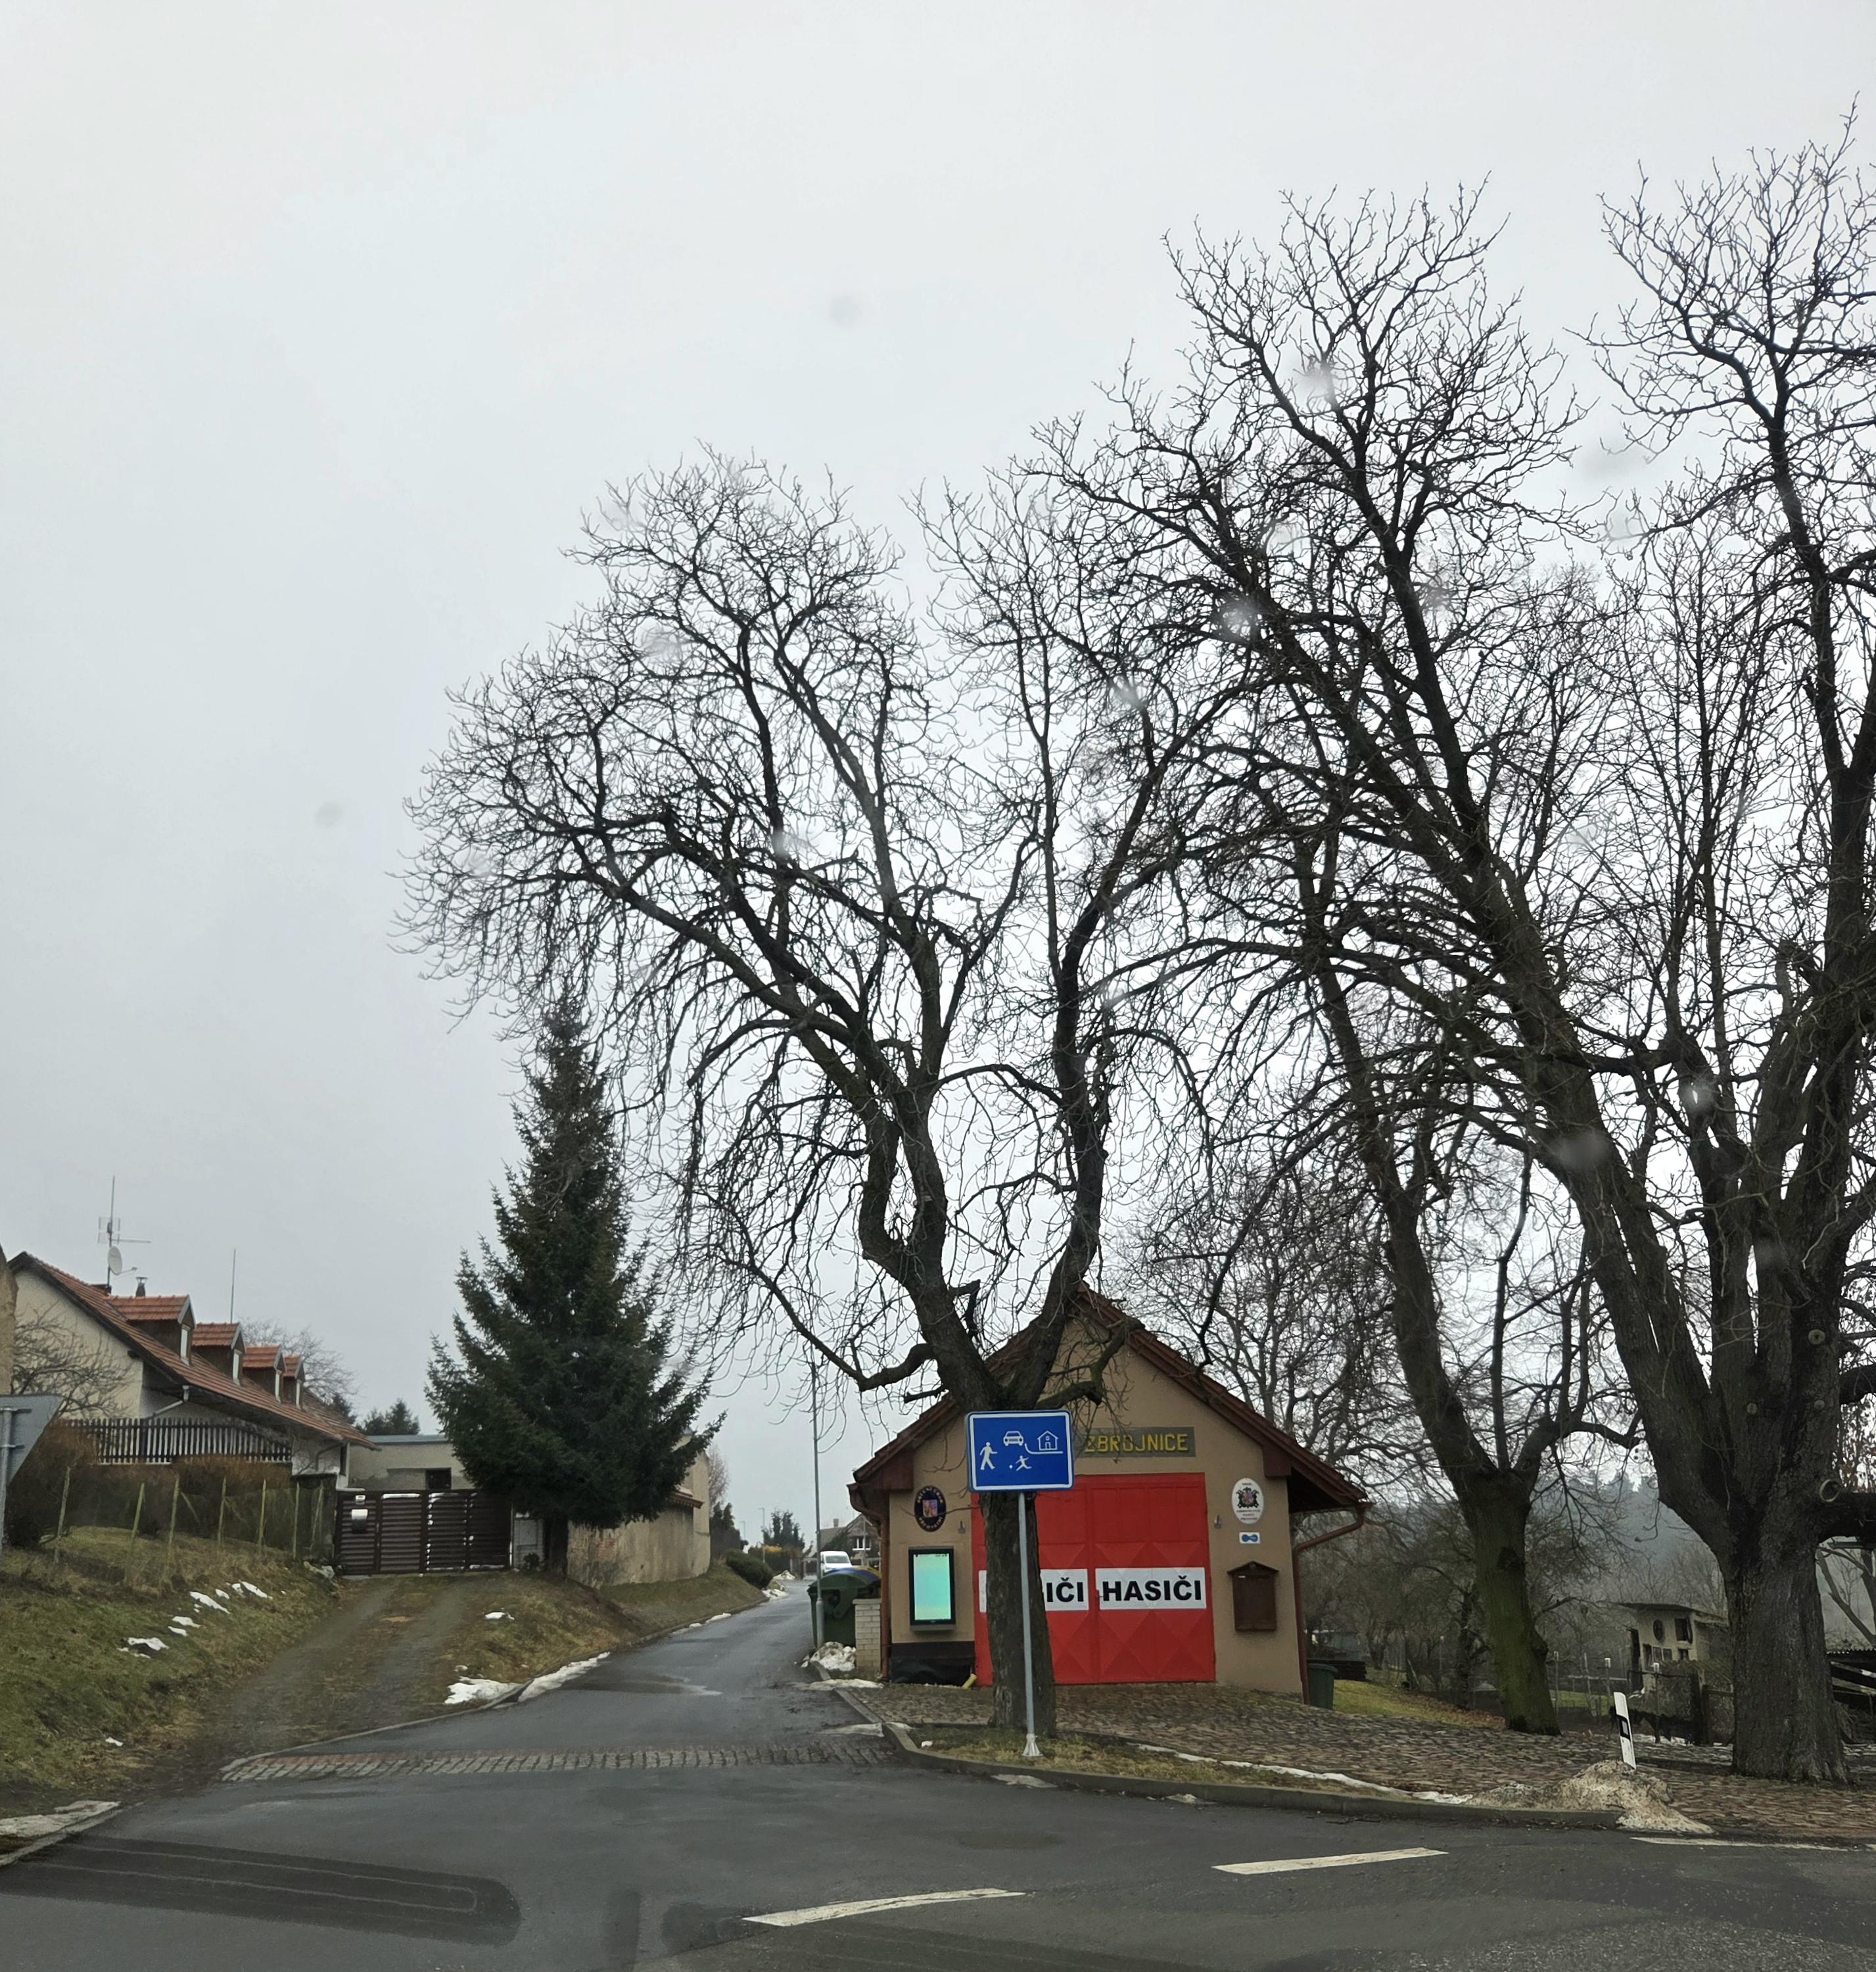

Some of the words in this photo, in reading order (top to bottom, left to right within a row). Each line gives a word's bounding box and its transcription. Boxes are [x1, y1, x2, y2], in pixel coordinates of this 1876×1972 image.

[1085, 1433, 1188, 1453] ZBROJNICE
[1046, 1576, 1085, 1603] IČI
[1102, 1575, 1202, 1602] HASIČI
